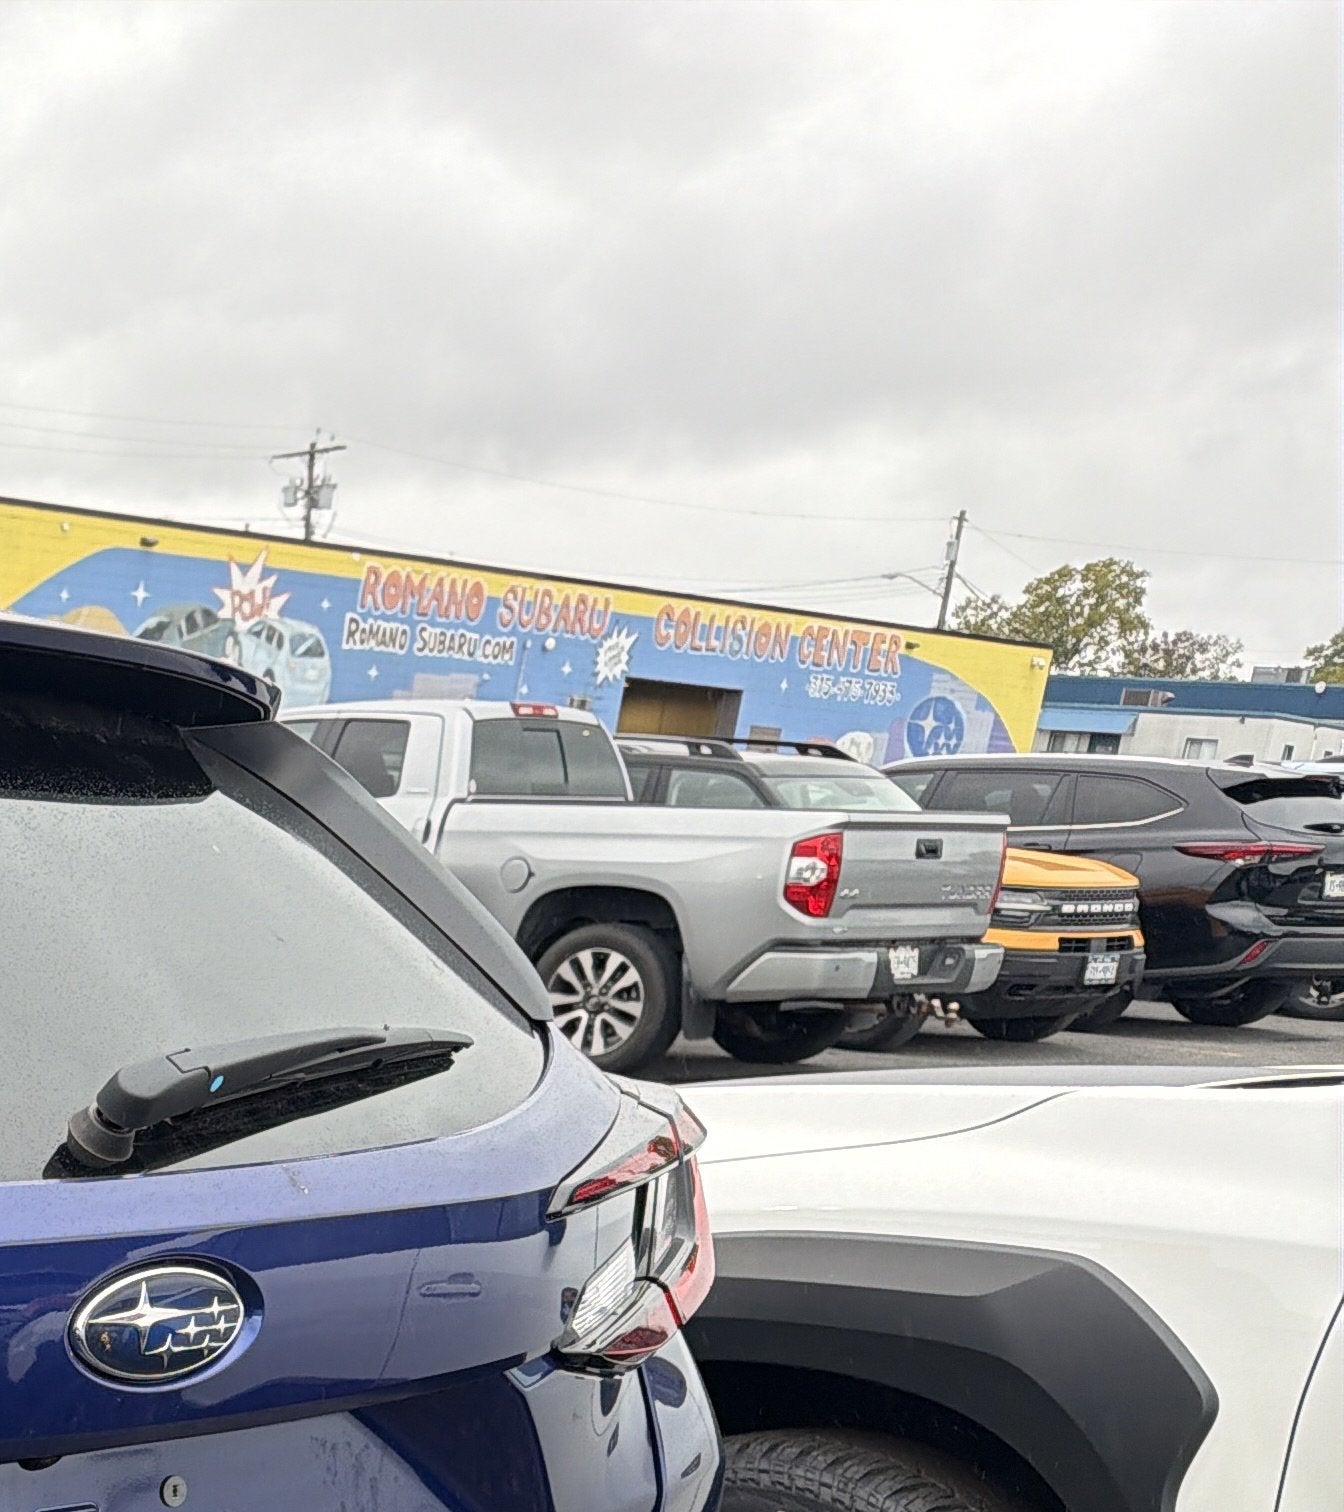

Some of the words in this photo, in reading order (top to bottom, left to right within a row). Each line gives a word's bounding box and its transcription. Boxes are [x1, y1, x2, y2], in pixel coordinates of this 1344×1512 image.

[358, 564, 487, 624] ROMANO
[497, 583, 612, 640] SUBARU
[653, 602, 793, 662] COLLISION
[797, 624, 903, 676] CENTER
